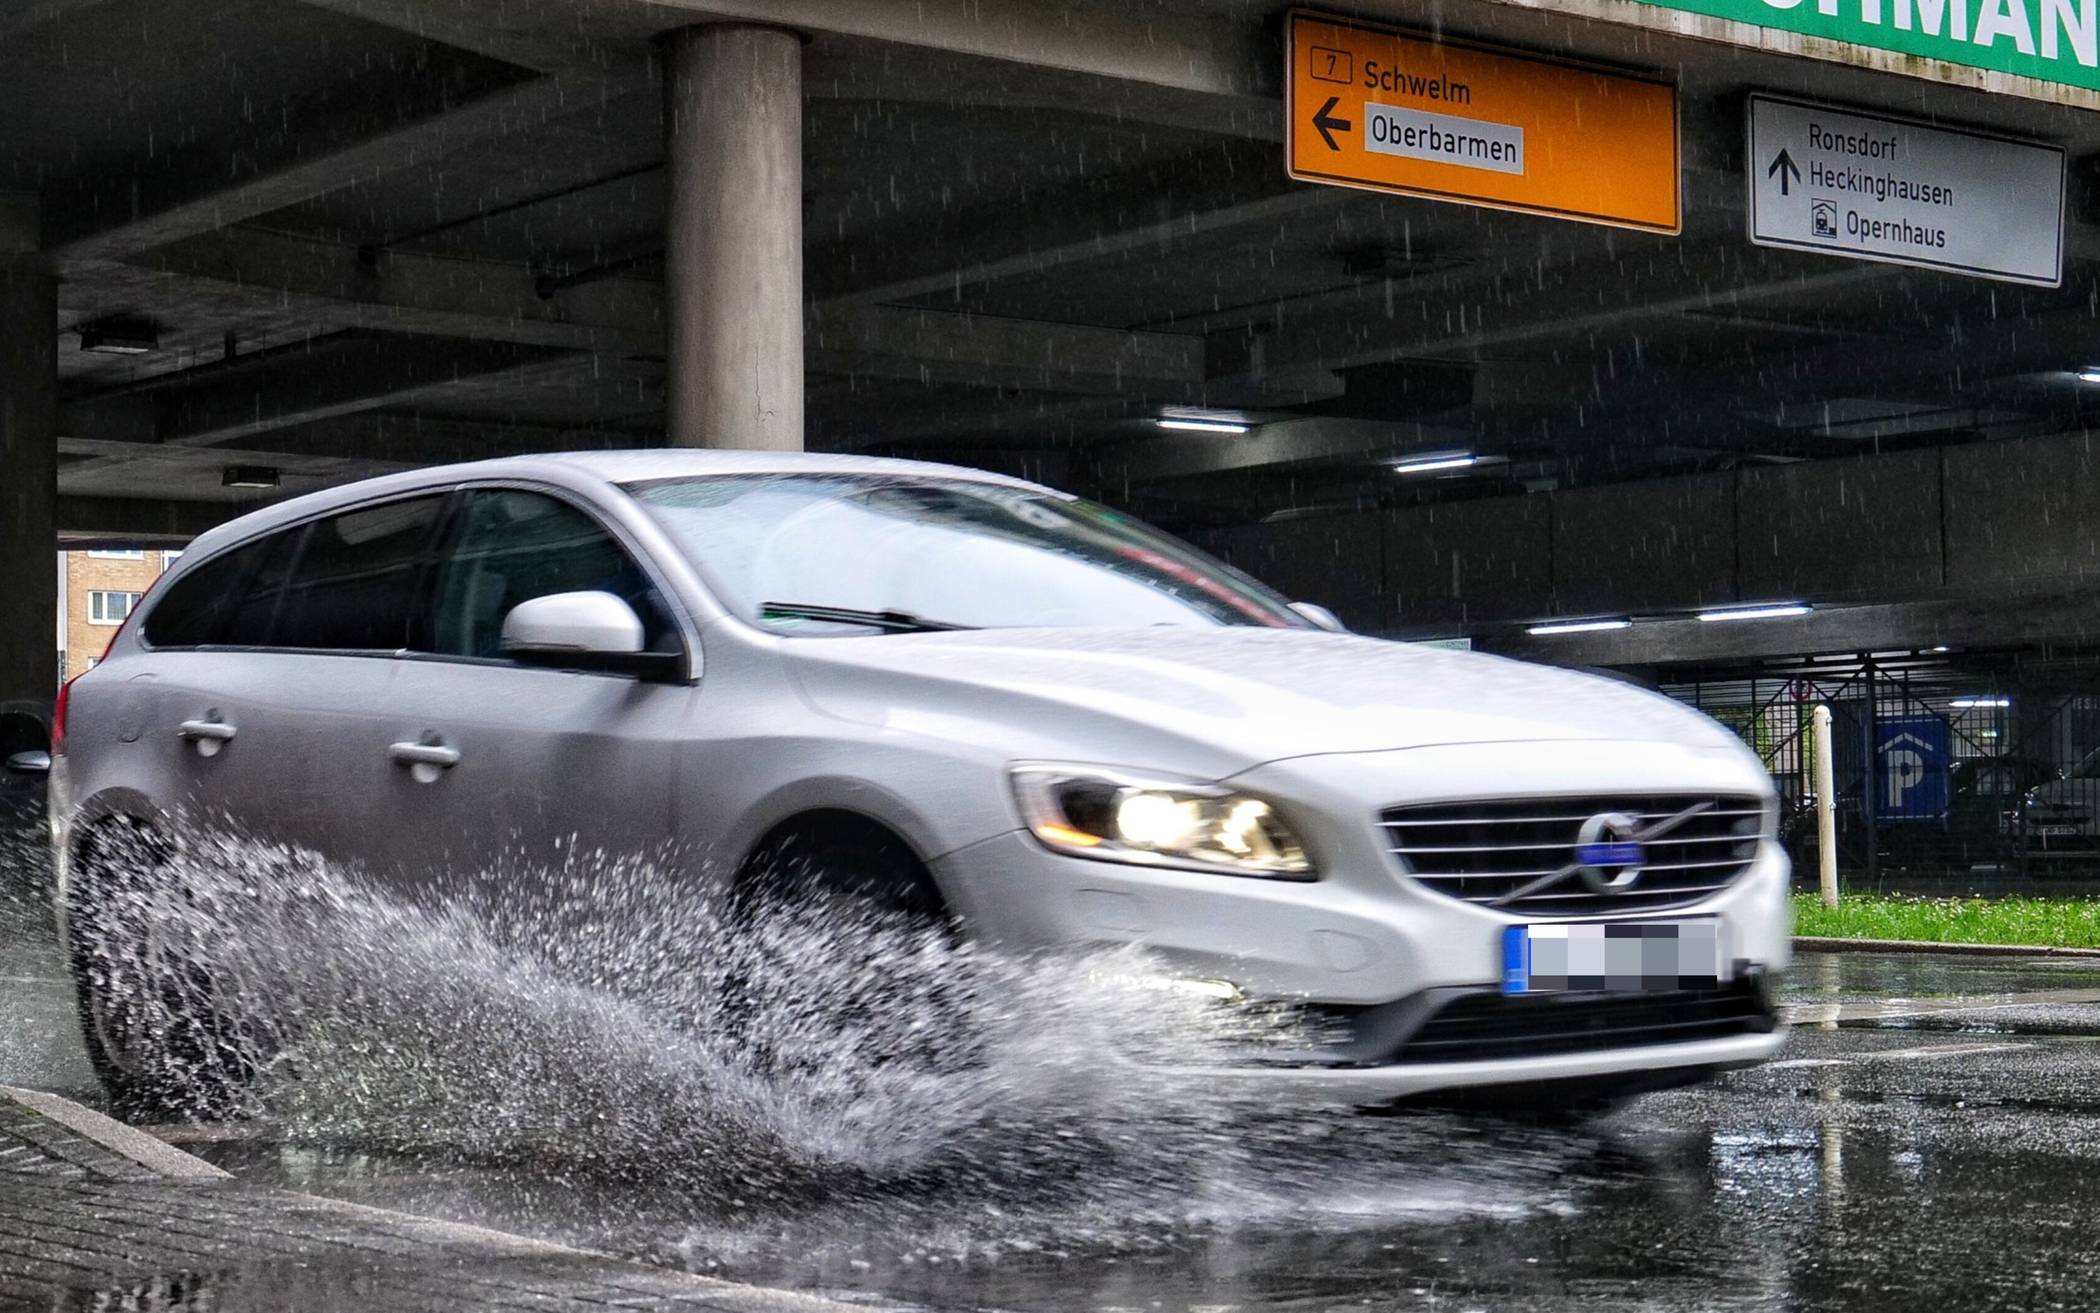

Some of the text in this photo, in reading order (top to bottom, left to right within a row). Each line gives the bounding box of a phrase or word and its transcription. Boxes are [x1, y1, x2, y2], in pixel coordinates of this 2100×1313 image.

[1327, 55, 1336, 75] 7
[1364, 60, 1471, 105] Schwelm
[1372, 115, 1516, 163] Oberbarmen
[1809, 123, 1897, 160] Ronsdorf
[1810, 161, 1953, 206] Heckinghausen
[1846, 210, 1946, 248] Opernhaus
[1888, 750, 1924, 807] P
